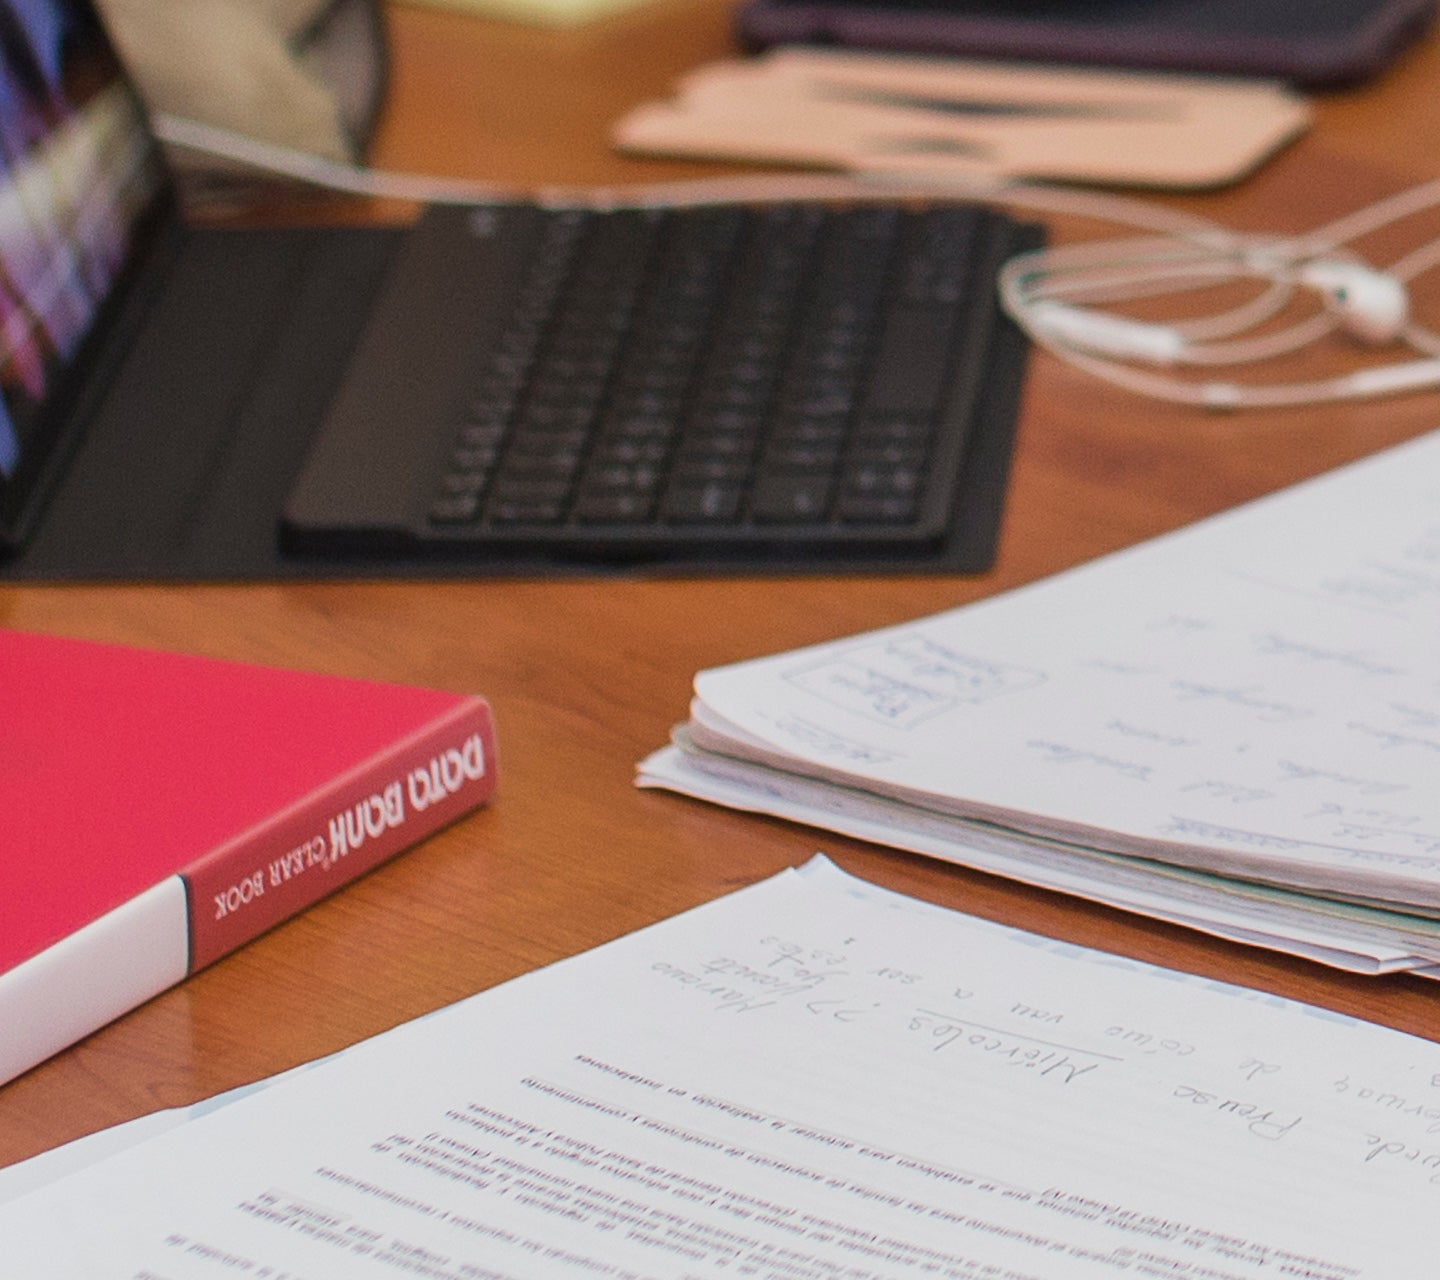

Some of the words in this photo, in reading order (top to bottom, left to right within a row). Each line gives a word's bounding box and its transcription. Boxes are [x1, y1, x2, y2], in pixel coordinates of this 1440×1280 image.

[269, 835, 327, 887] CLEAR
[214, 869, 265, 920] BOOK
[571, 1053, 664, 1090] instalaciones
